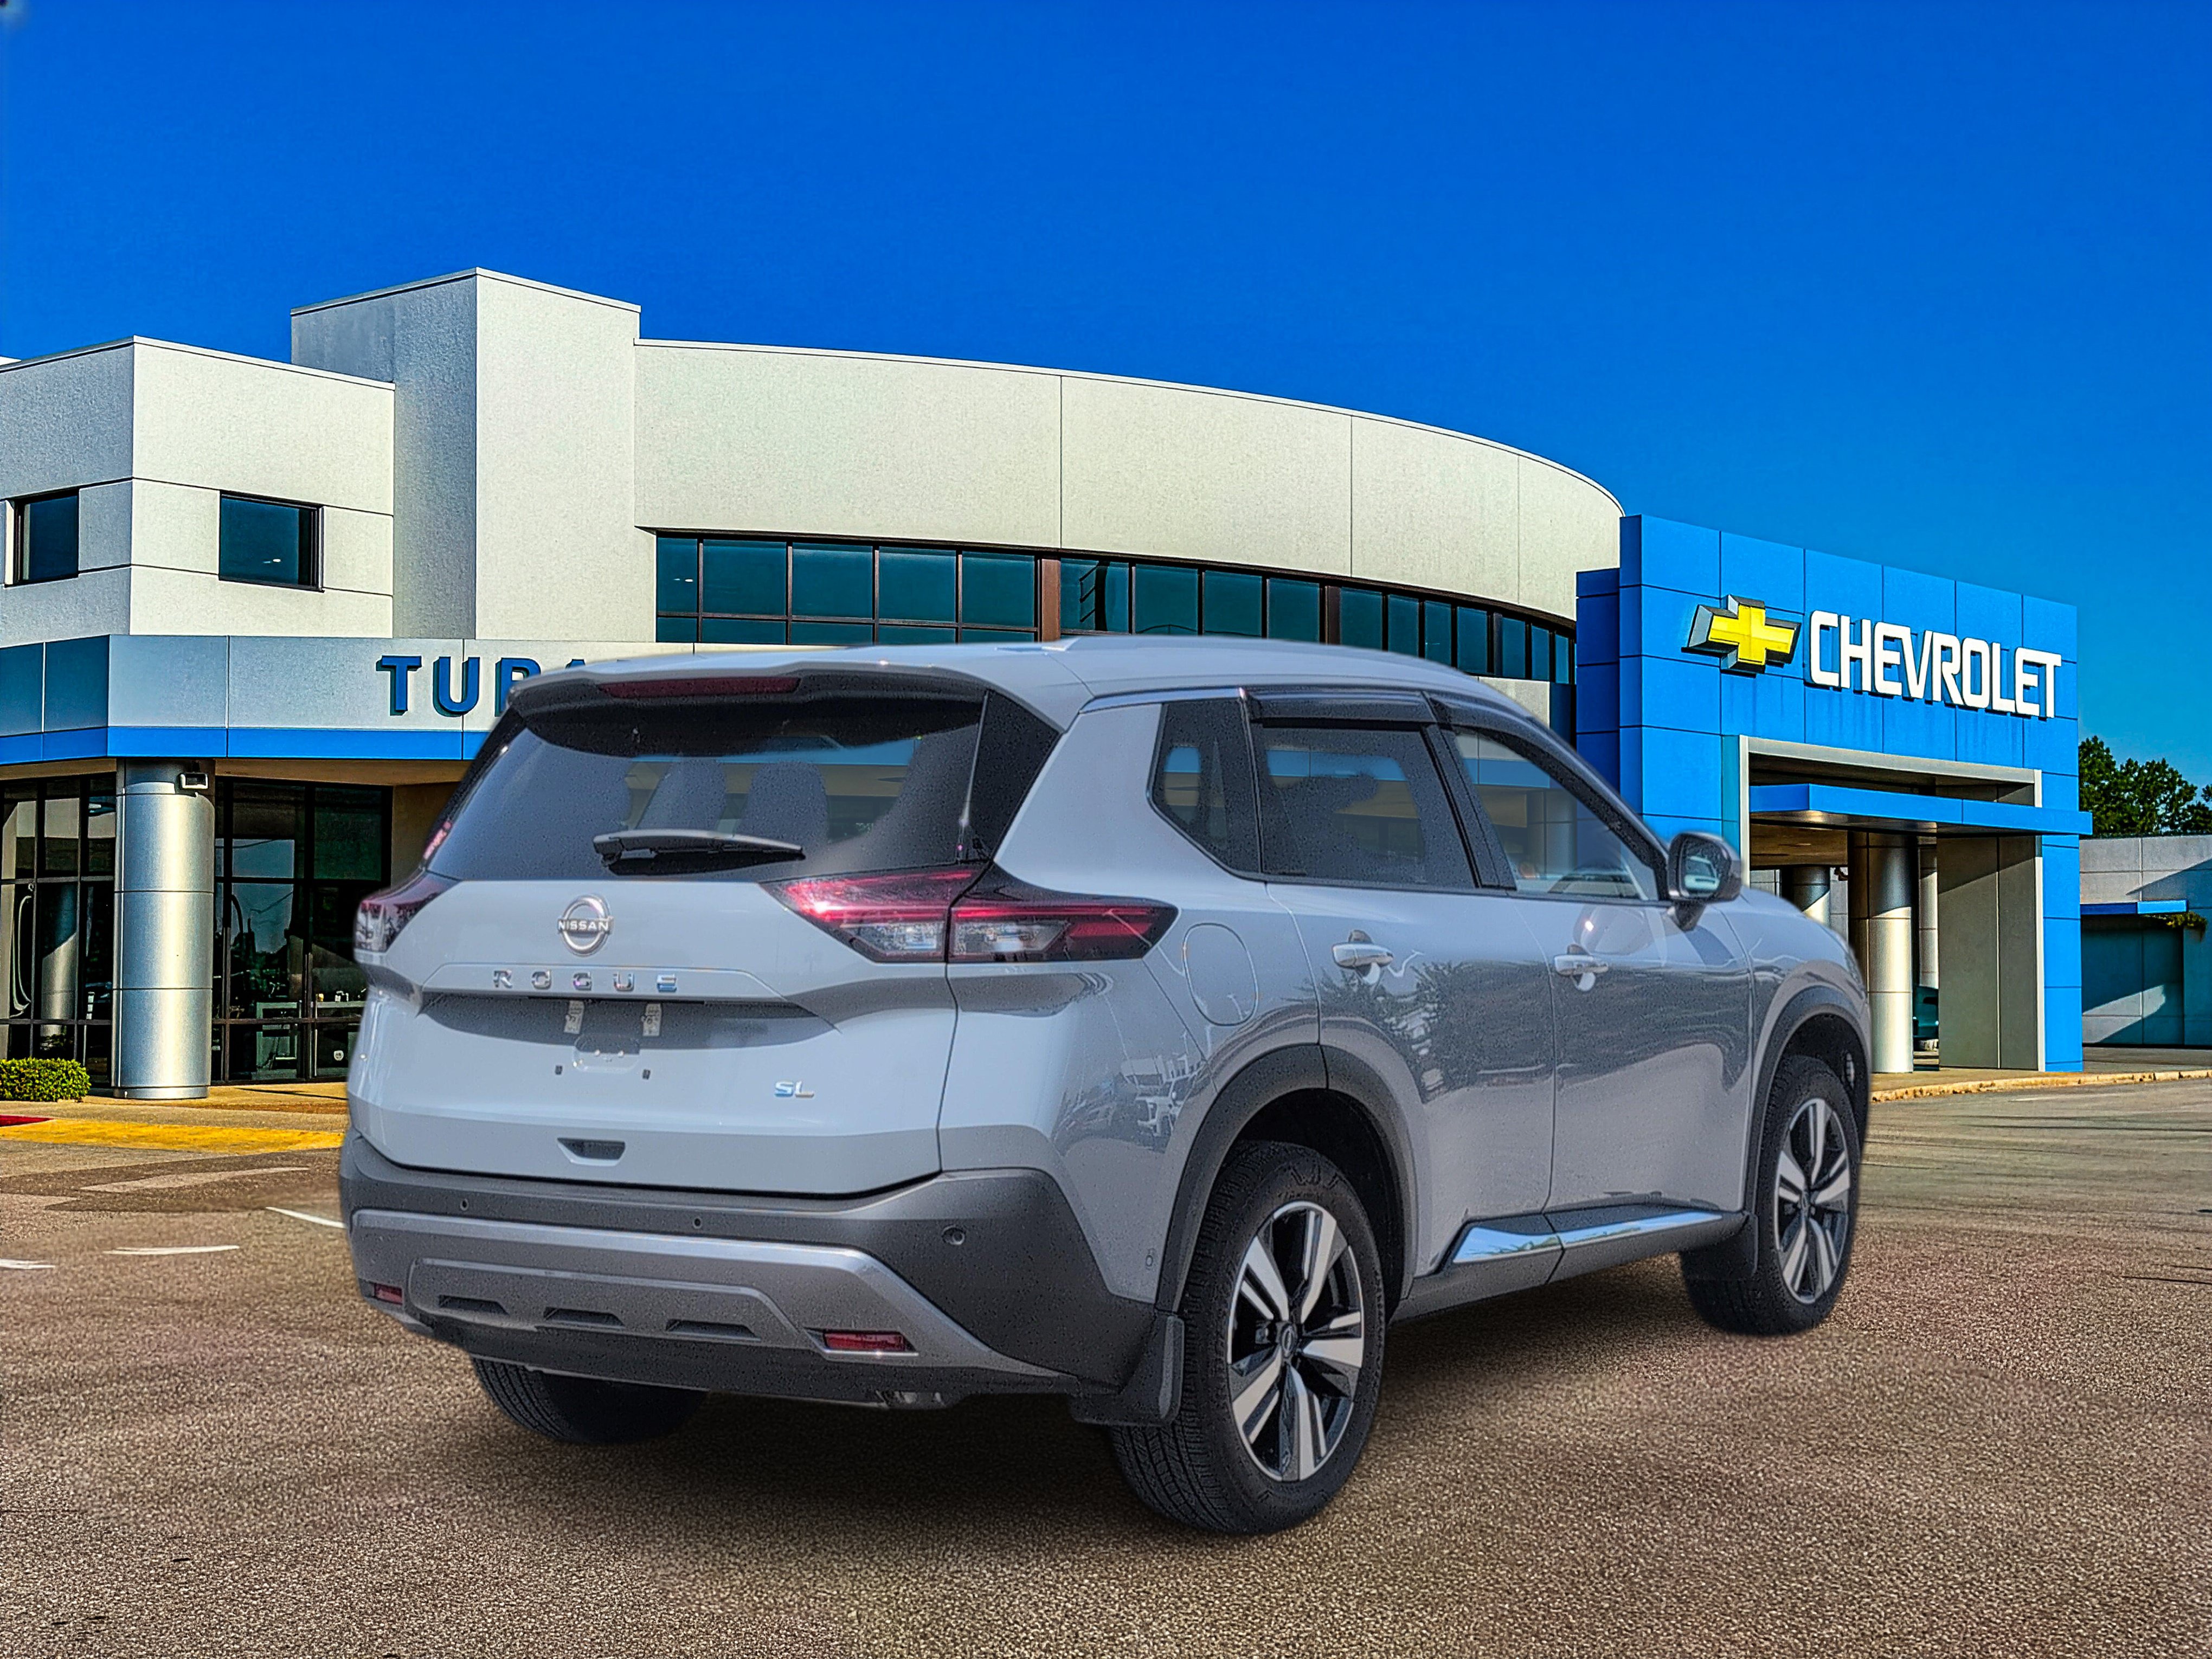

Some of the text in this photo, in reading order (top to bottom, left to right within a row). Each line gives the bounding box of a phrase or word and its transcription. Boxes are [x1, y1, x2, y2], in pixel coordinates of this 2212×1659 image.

[1810, 610, 2062, 718] CHEVROLET
[558, 919, 609, 931] NISSAN
[493, 969, 677, 993] ROGUE
[774, 1081, 814, 1098] SL
